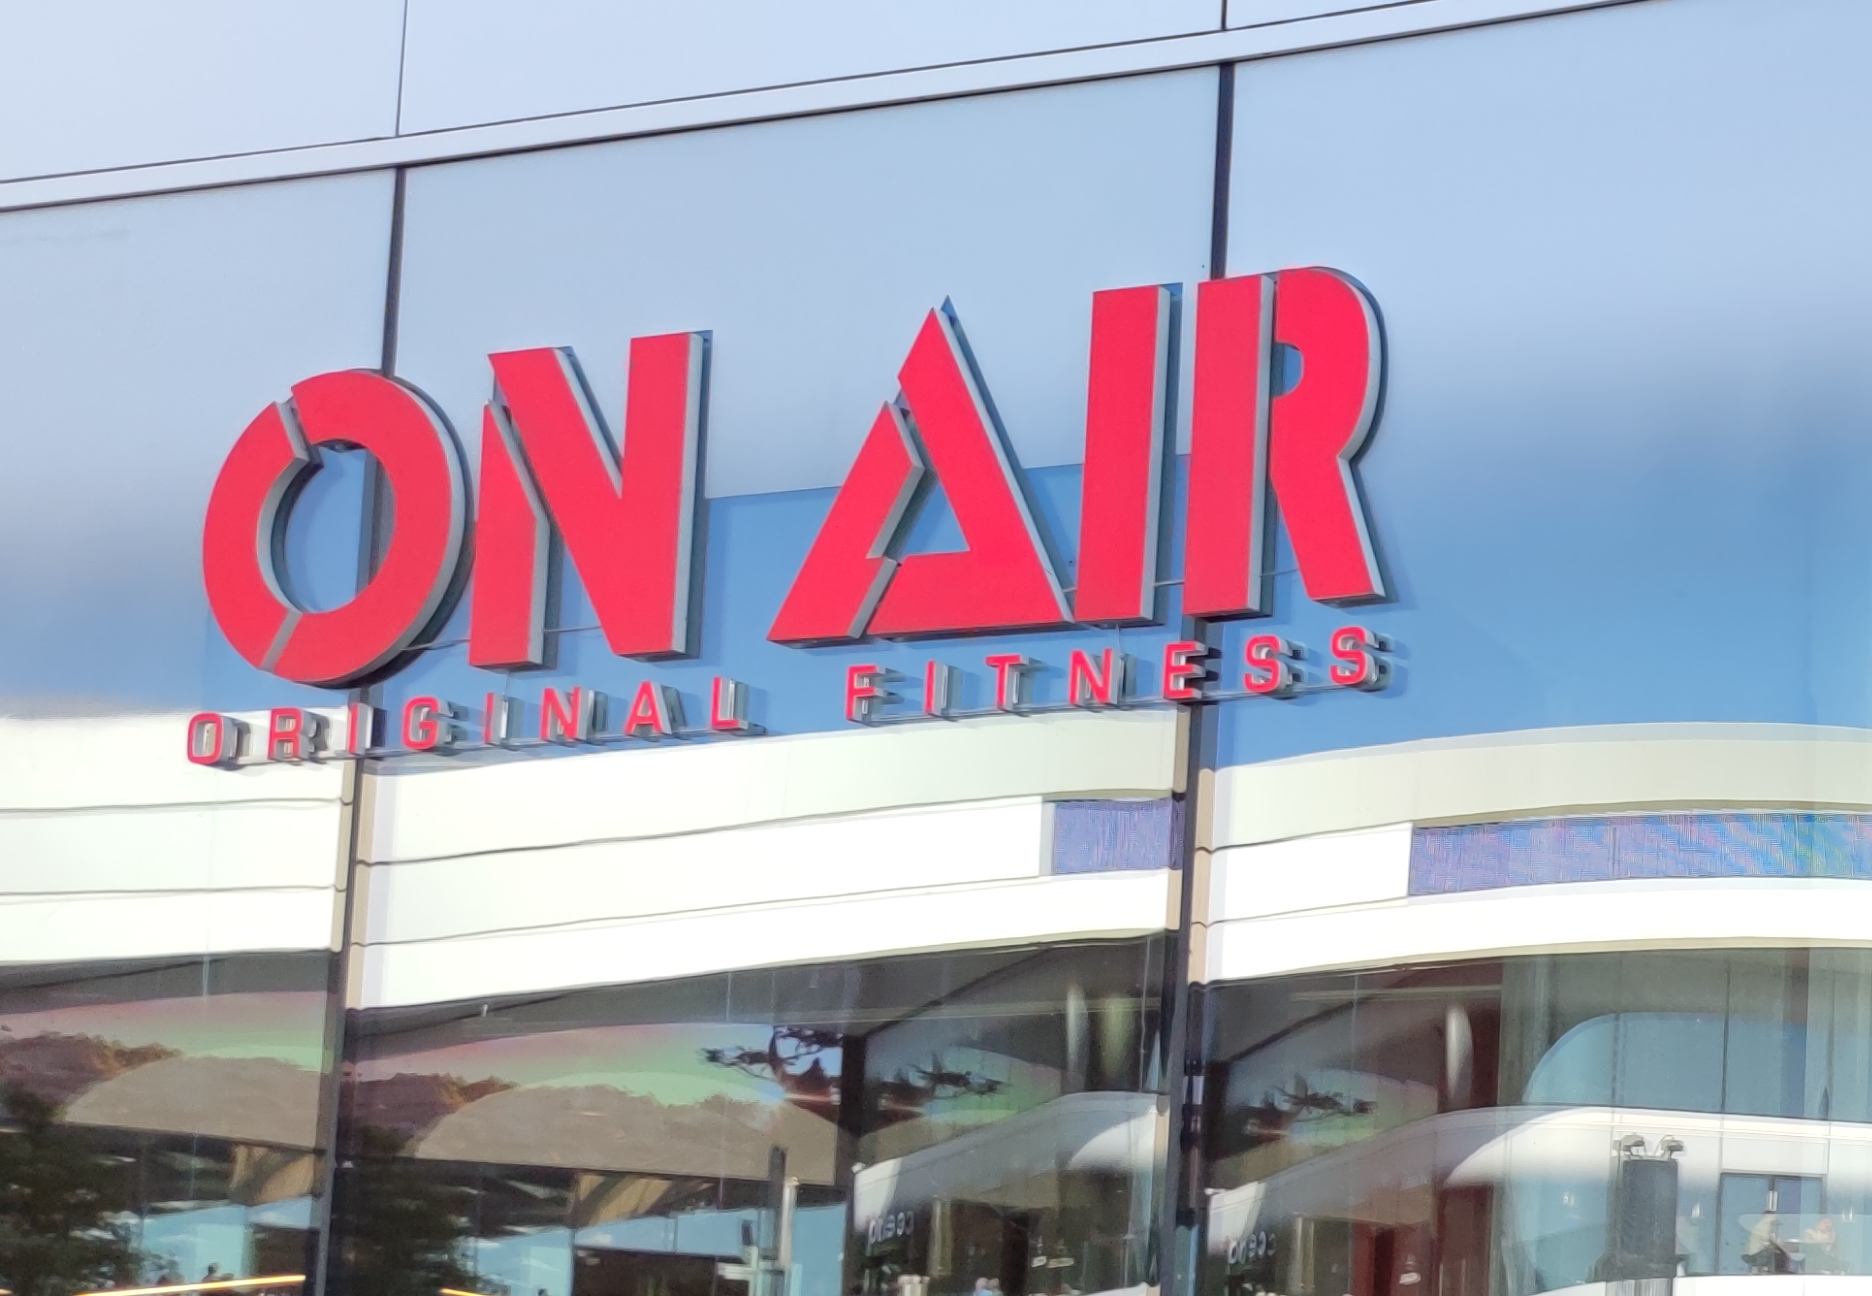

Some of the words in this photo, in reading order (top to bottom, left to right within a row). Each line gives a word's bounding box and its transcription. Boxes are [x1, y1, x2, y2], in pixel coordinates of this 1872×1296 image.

[203, 331, 712, 685] ON
[767, 267, 1387, 643] AIR
[186, 675, 755, 766] ORIGINAL
[845, 625, 1387, 722] FITNESS
